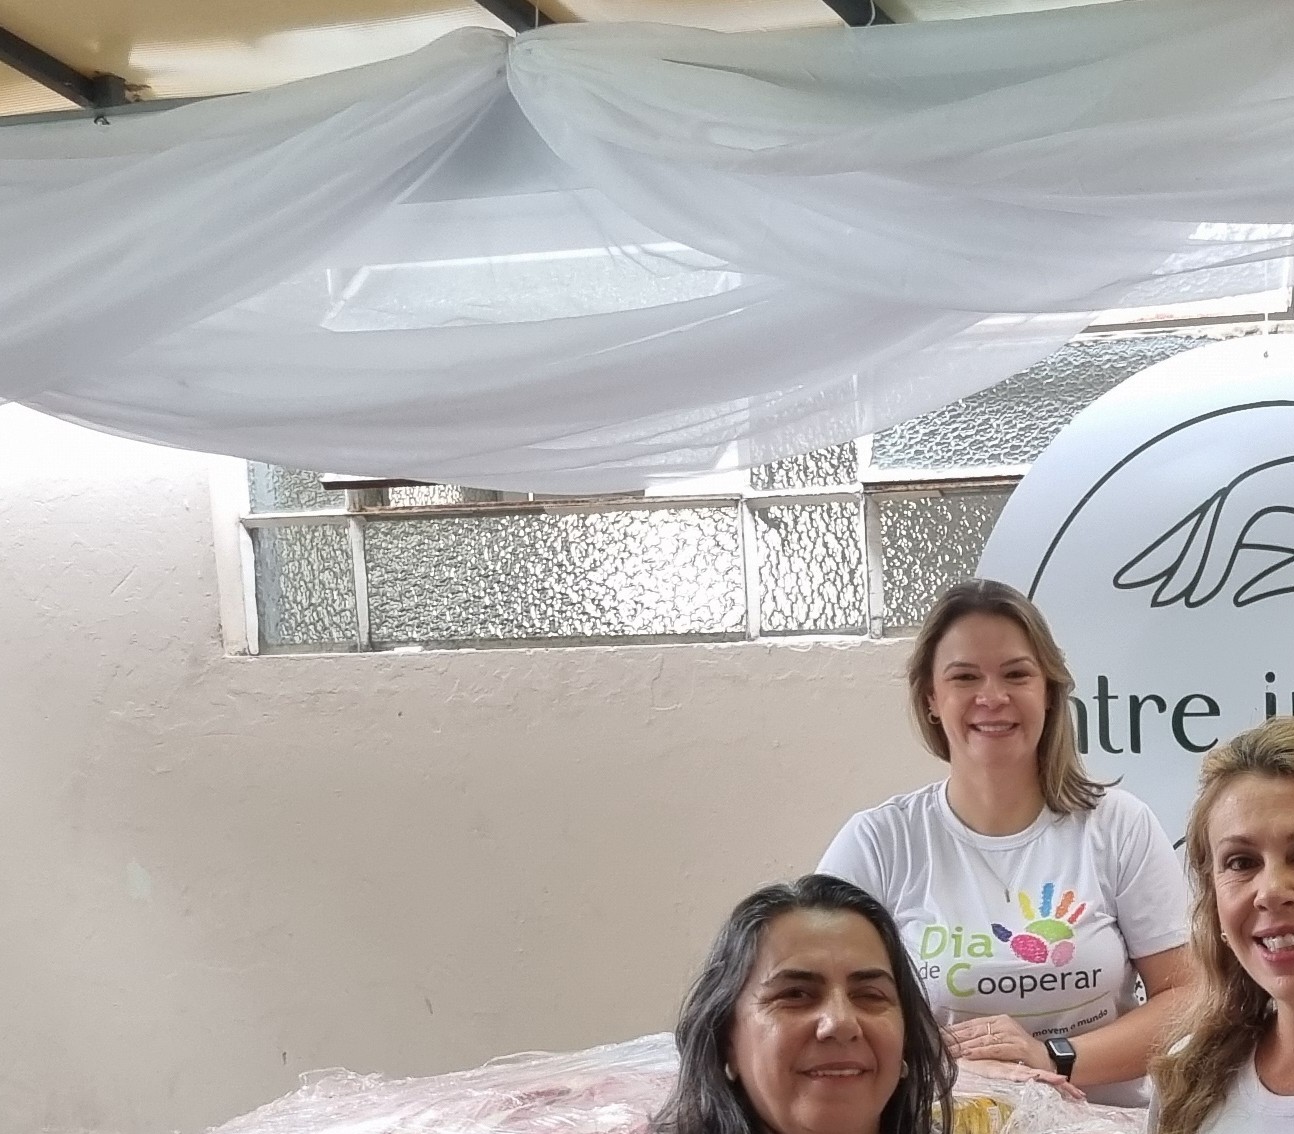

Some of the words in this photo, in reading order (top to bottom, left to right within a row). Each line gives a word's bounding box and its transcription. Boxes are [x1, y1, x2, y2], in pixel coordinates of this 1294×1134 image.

[1076, 675, 1221, 755] ntre
[919, 925, 993, 960] Dia
[918, 962, 940, 980] de
[946, 962, 1102, 998] Cooperar
[1032, 1026, 1069, 1038] movem
[1077, 1009, 1108, 1027] mundo
